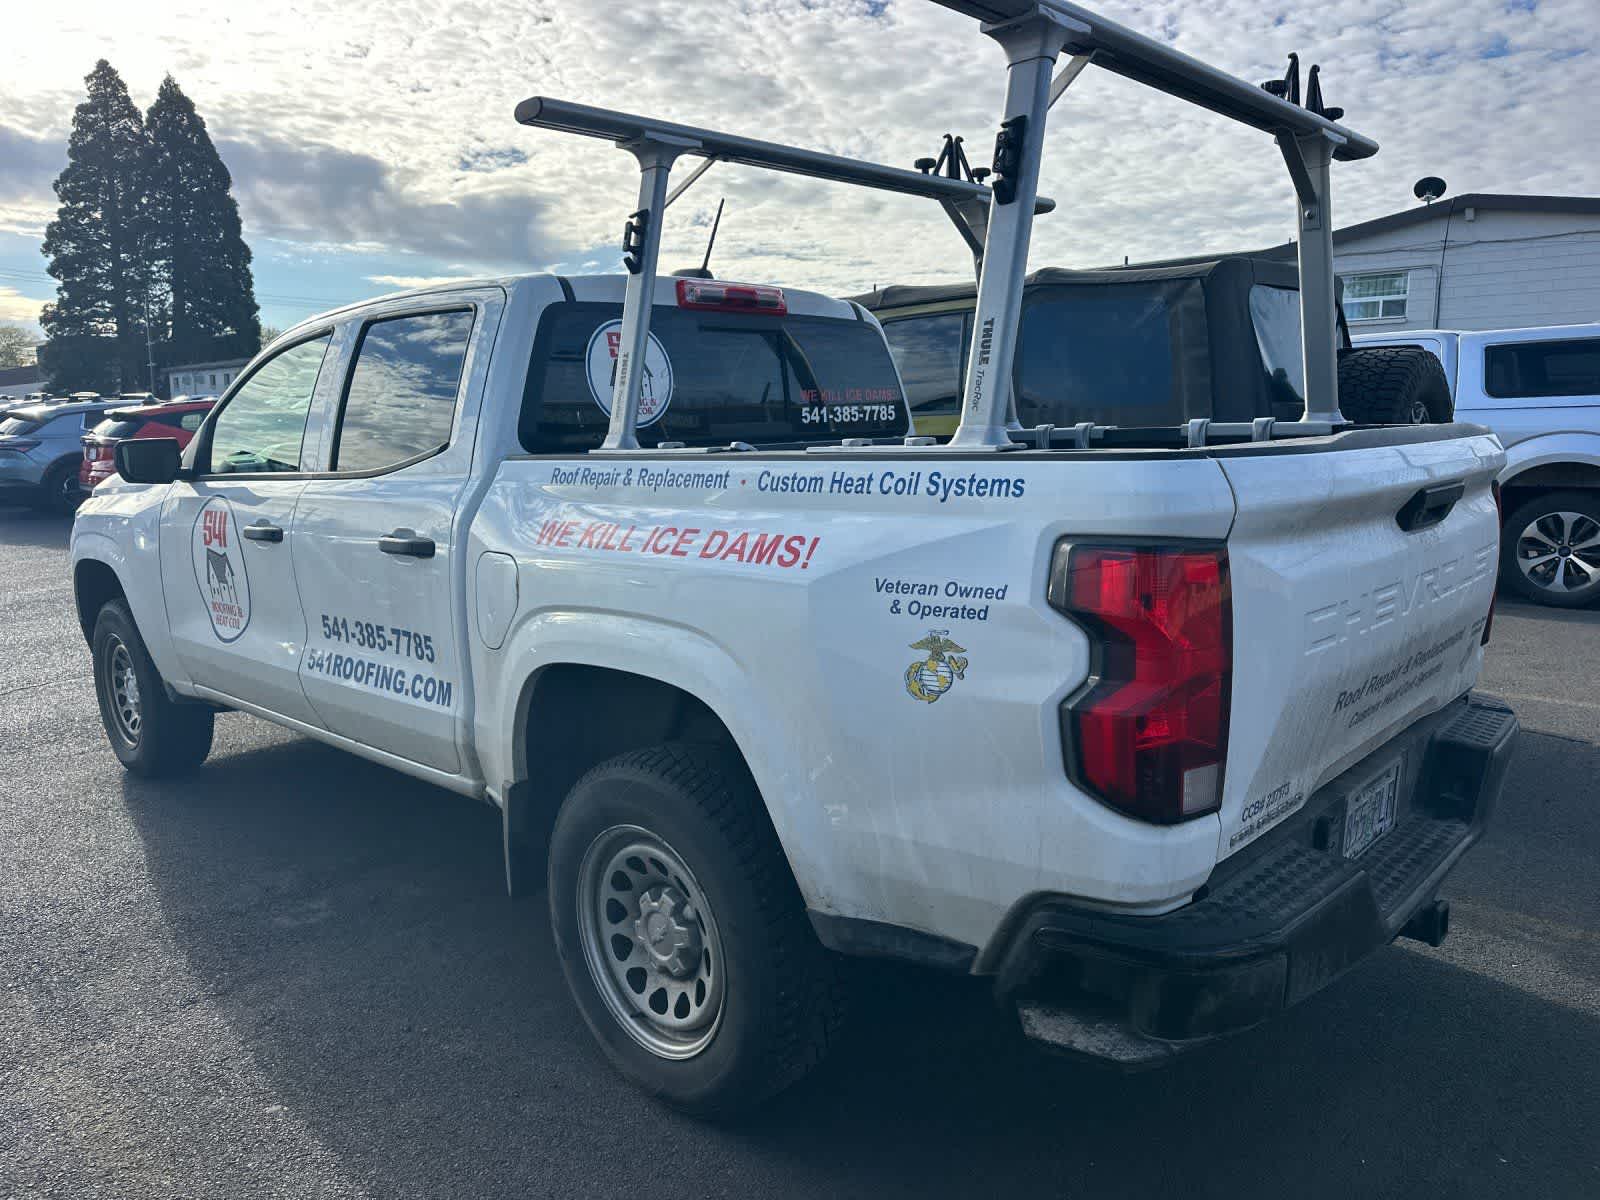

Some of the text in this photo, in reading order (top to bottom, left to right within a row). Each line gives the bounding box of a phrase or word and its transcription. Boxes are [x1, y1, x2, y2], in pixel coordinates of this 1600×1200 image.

[801, 405, 896, 424] 541-385-7785
[551, 467, 1026, 502] Roof Repair & Replacement Custom Heat Coil Systems
[203, 510, 228, 548] 541
[535, 519, 821, 569] WE KILL ICE DAMS!
[875, 577, 1009, 600] Veteran Owned
[889, 599, 990, 621] & Operated
[321, 614, 435, 664] 541-385-7785
[307, 649, 453, 707] 541ROOFING.COM
